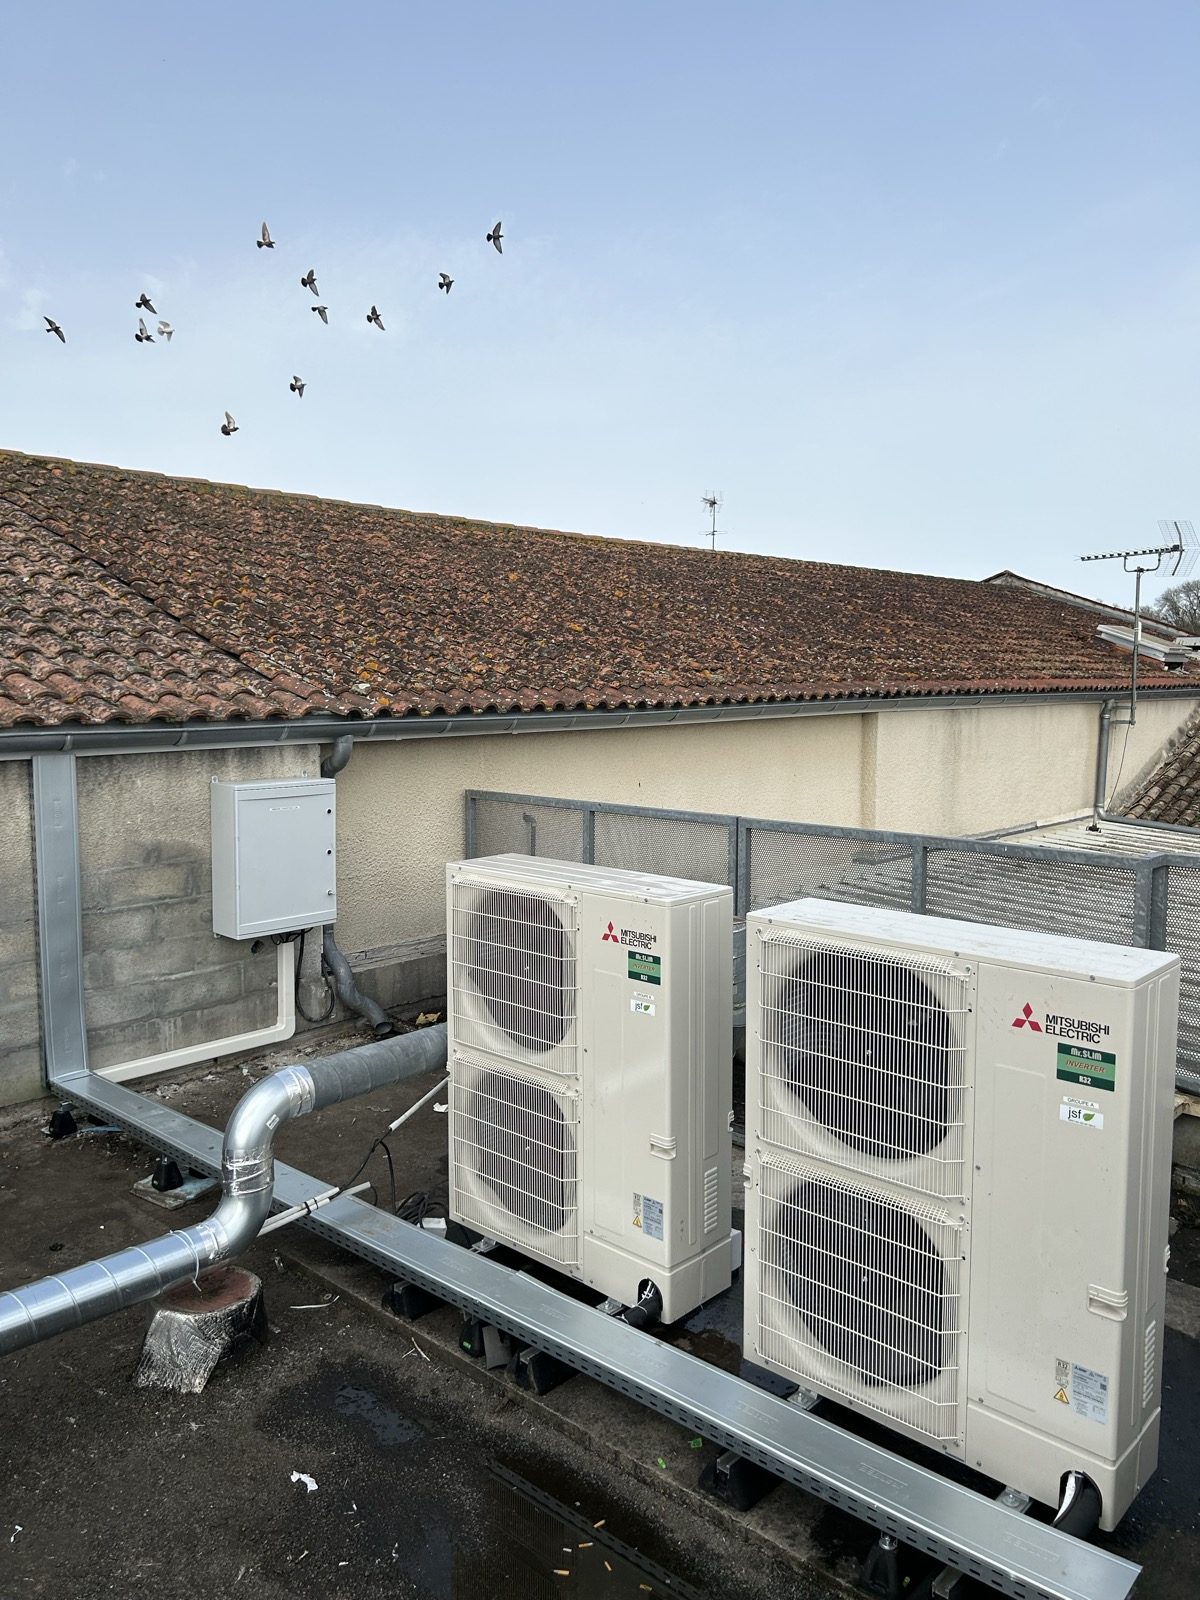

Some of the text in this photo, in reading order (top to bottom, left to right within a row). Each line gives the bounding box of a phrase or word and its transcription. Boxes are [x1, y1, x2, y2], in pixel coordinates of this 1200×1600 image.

[620, 928, 657, 943] MITSUBISHI
[620, 937, 652, 950] ELECTRIC
[1045, 1013, 1110, 1035] MITSUBISHI
[1045, 1024, 1101, 1044] ELECTRIC
[1066, 1060, 1105, 1074] INVERTER
[1067, 1107, 1081, 1120] jsf
